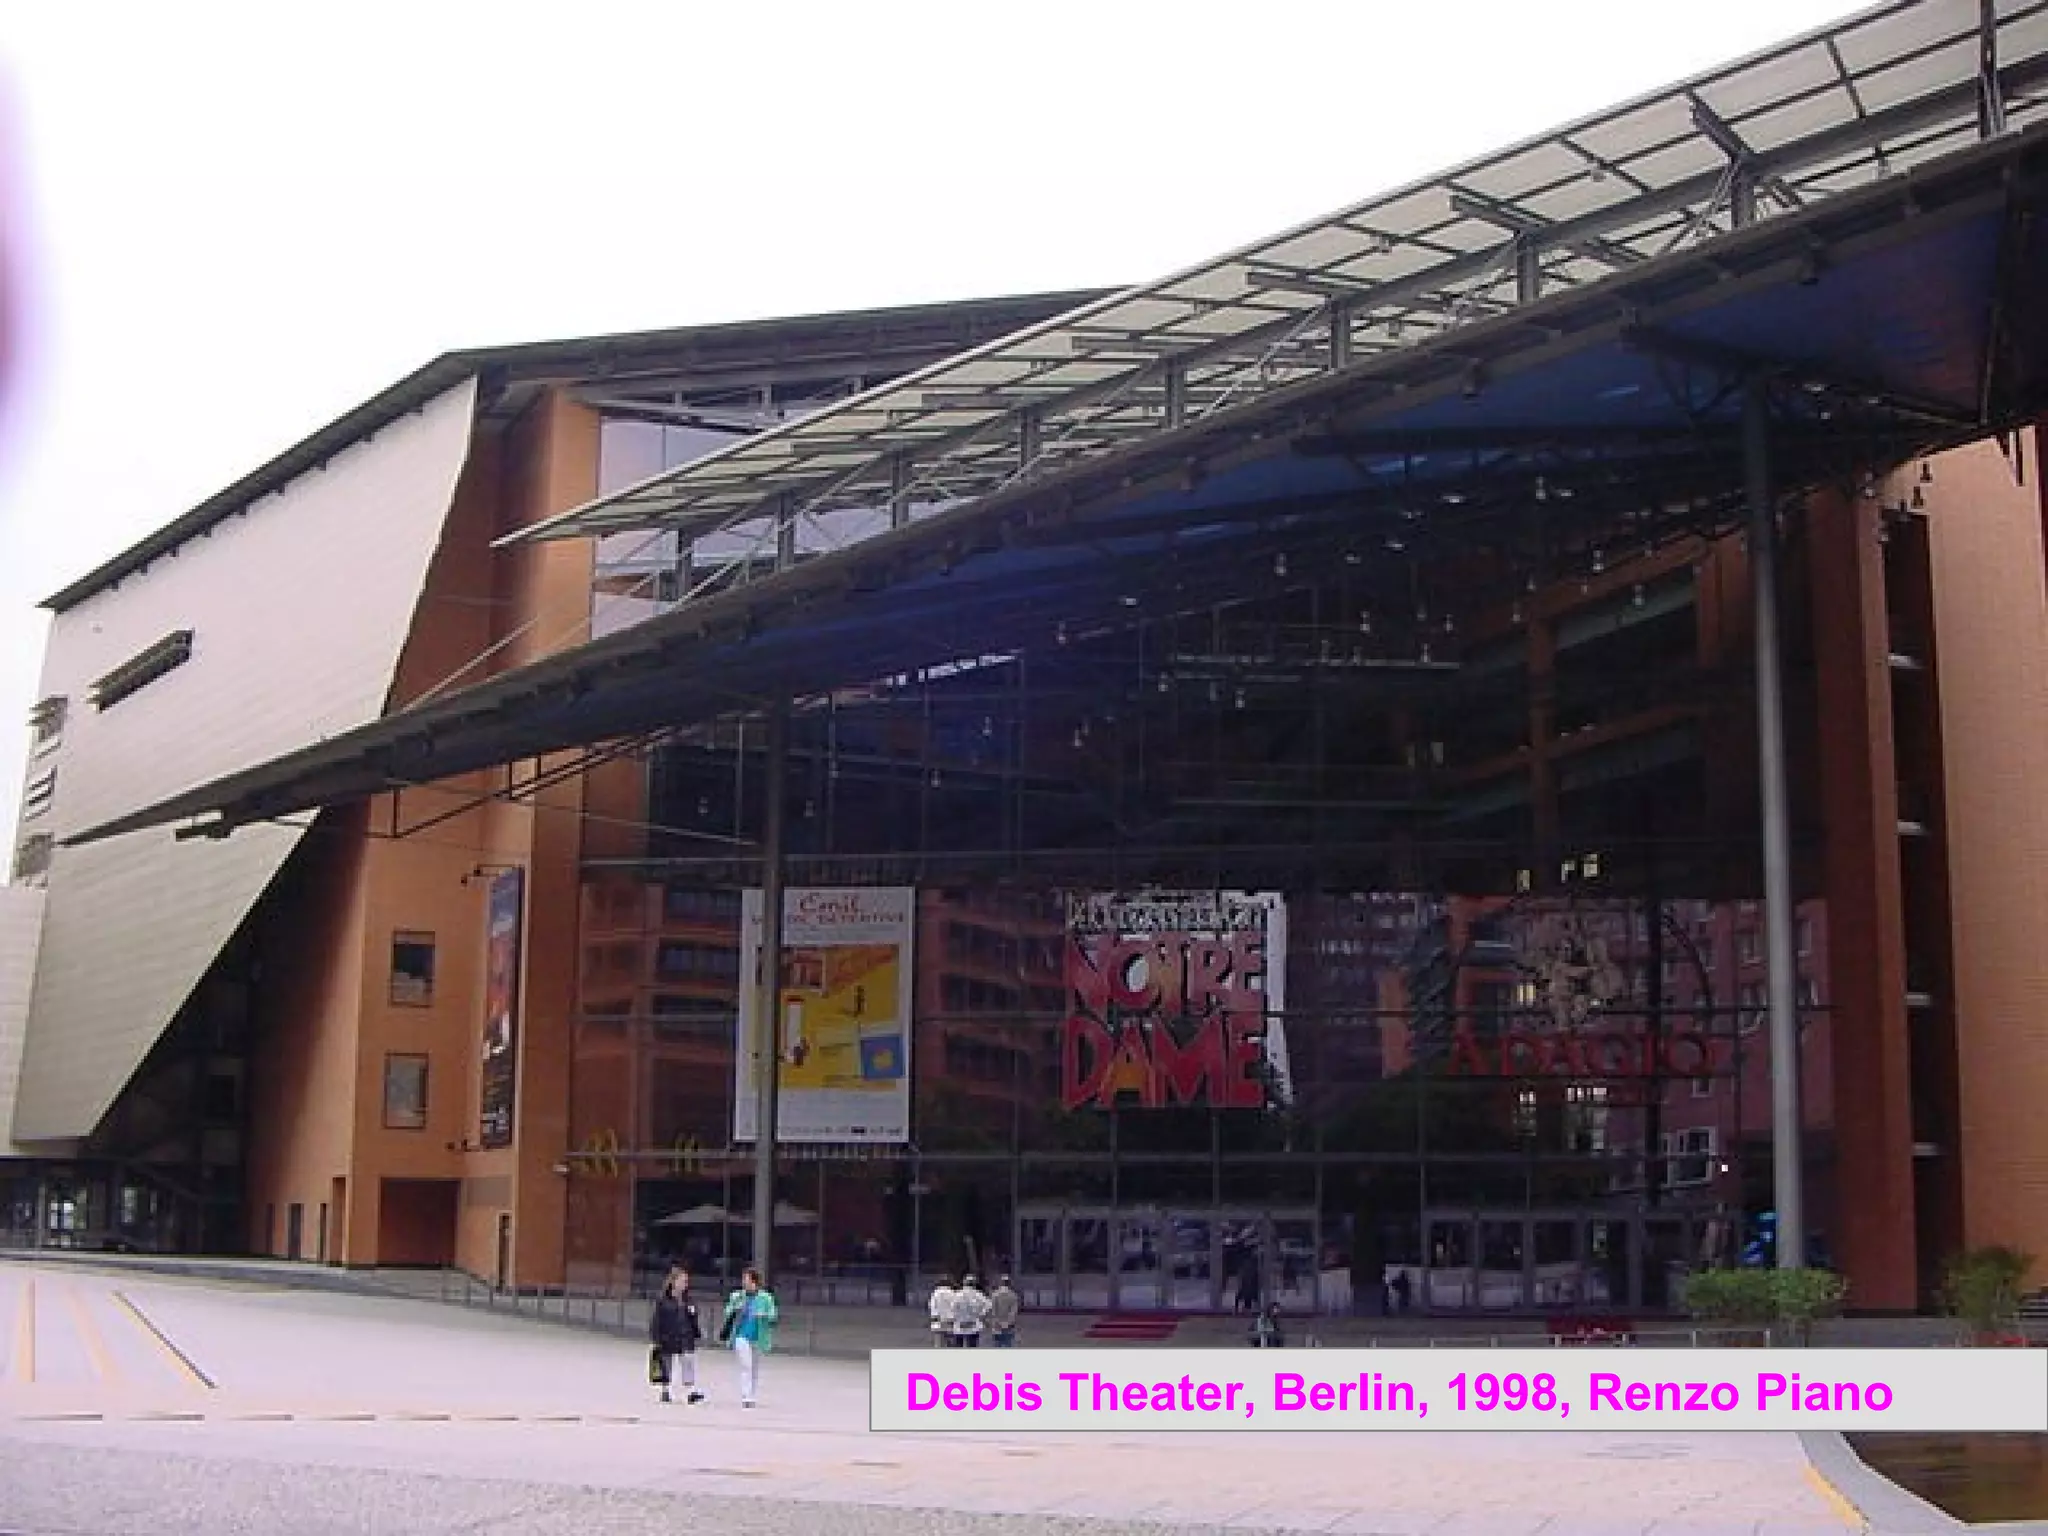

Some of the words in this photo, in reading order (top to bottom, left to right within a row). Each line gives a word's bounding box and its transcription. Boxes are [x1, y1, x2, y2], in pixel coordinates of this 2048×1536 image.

[1063, 930, 1263, 1018] NOTRE
[1060, 1013, 1264, 1110] DAME
[1445, 1030, 1712, 1077] ADAGIO
